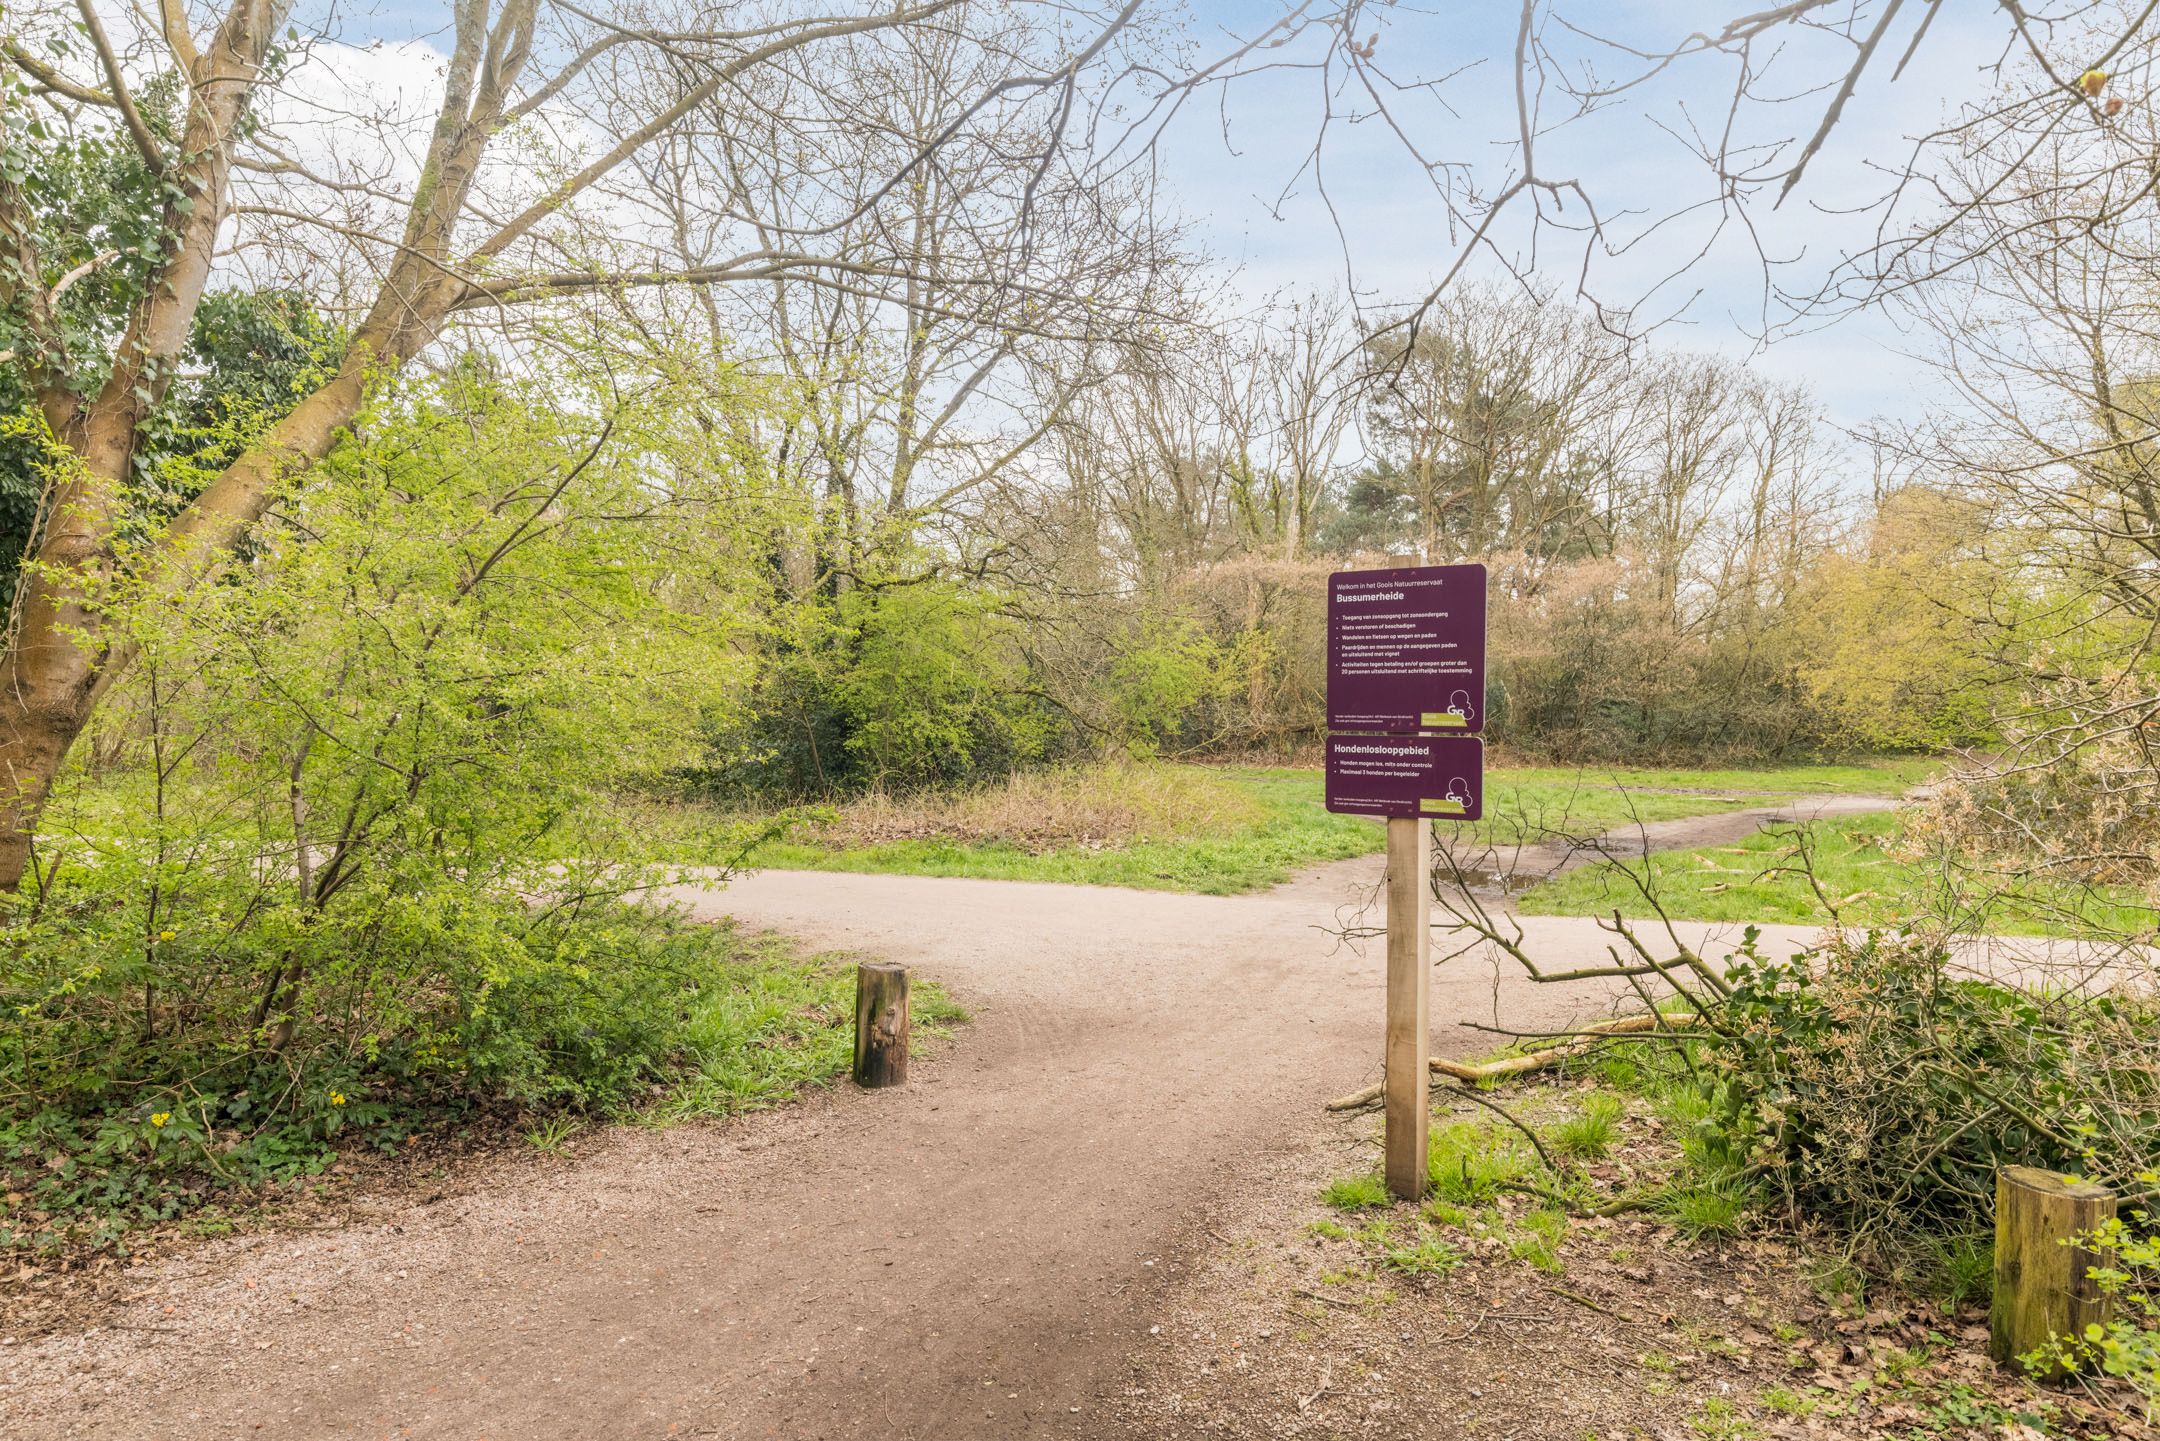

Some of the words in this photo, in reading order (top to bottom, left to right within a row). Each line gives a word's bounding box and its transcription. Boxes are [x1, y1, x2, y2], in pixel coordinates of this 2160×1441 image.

[1394, 579, 1443, 587] Natuurreservaat
[1336, 592, 1404, 603] Bussumerheide
[1334, 744, 1429, 756] Hondenlosloopgebied
